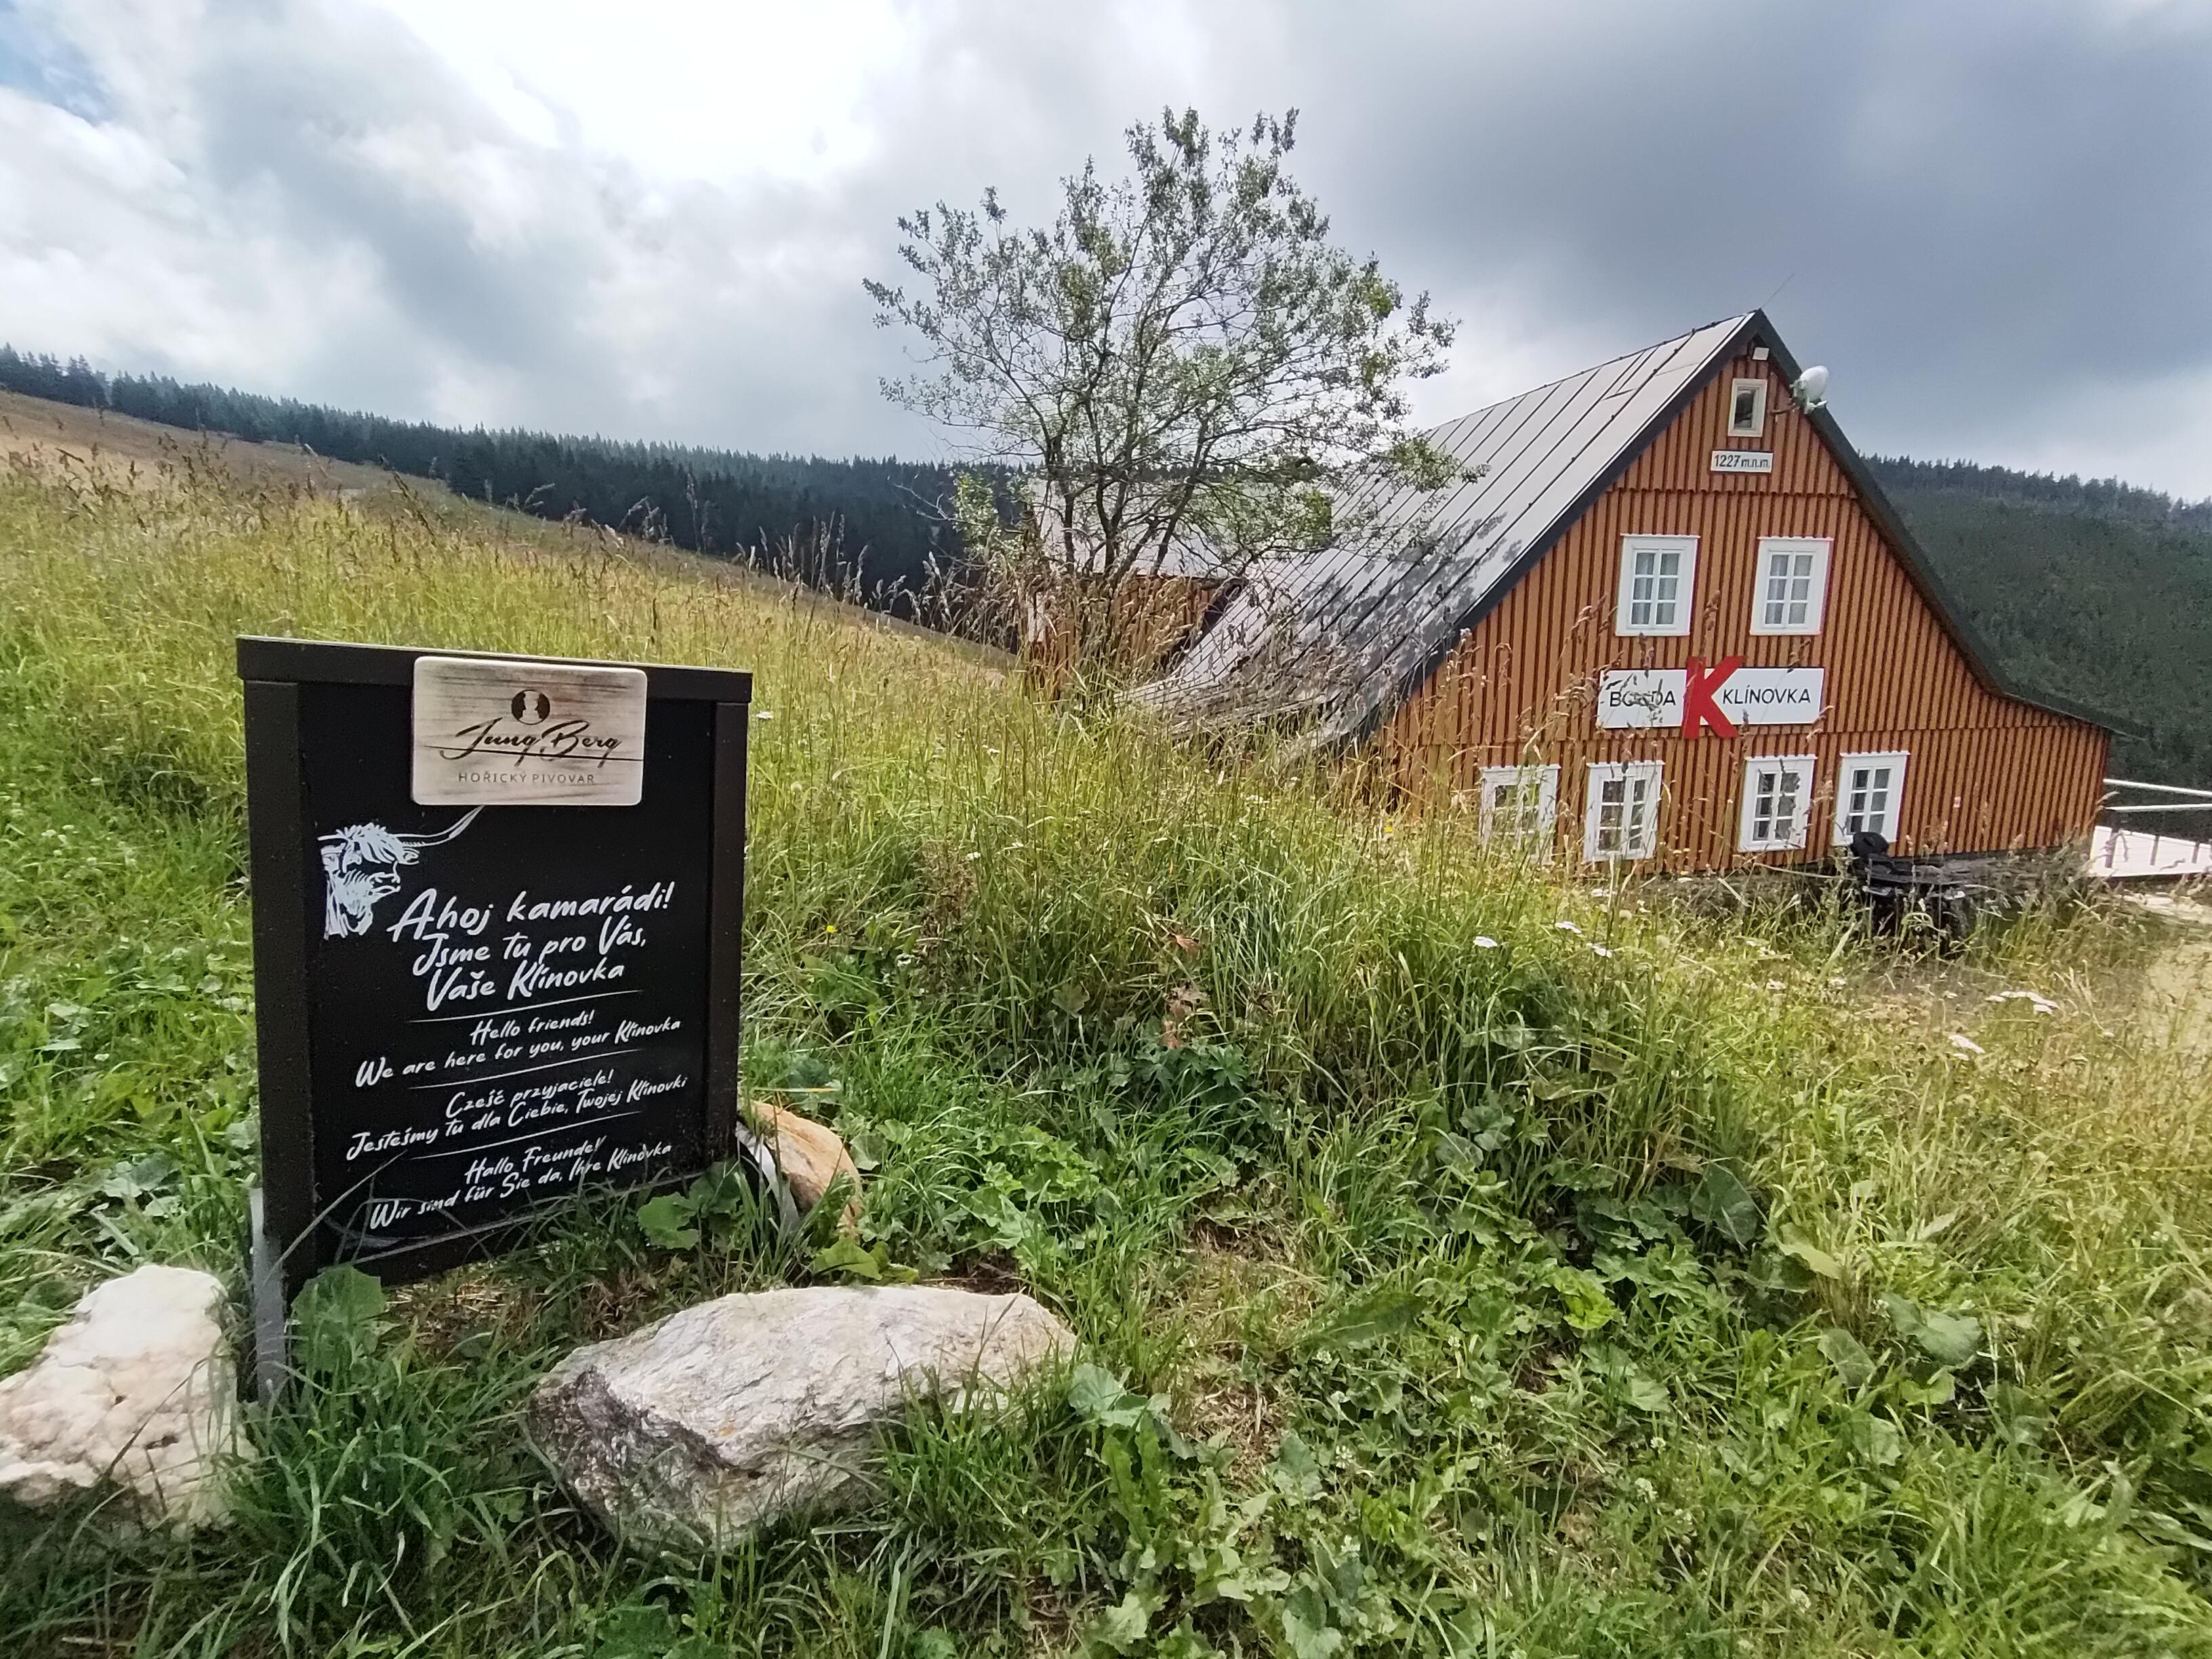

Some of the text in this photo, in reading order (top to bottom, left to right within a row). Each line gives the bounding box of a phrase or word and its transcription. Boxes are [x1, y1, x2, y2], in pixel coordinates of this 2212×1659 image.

[1715, 455, 1741, 468] 1227
[1681, 655, 1746, 739] K
[1722, 684, 1811, 705] KLÍNOVKA
[440, 717, 622, 768] Jung Berg
[459, 771, 594, 784] HOŘICKÝ PIVOVAR
[386, 881, 675, 942] Ahoj kamarádi!
[413, 916, 646, 976] Jsme tu pro Vás,
[427, 957, 624, 1011] Vaše Klínovka
[356, 1017, 680, 1087] We are here for you, your Klínovka
[470, 1010, 594, 1046] Hello friends!
[346, 1074, 688, 1160] Jesteśmy tu dla Ciebie, Twojej Klínovki
[446, 1069, 614, 1118] Cześć przyjaciele!
[464, 1140, 601, 1185] Hallo Freunde!
[370, 1200, 411, 1229] Wir
[417, 1190, 461, 1214] sind
[464, 1185, 494, 1202] für
[500, 1172, 530, 1198] Sie
[538, 1167, 562, 1184] da,
[569, 1157, 601, 1181] Ihre
